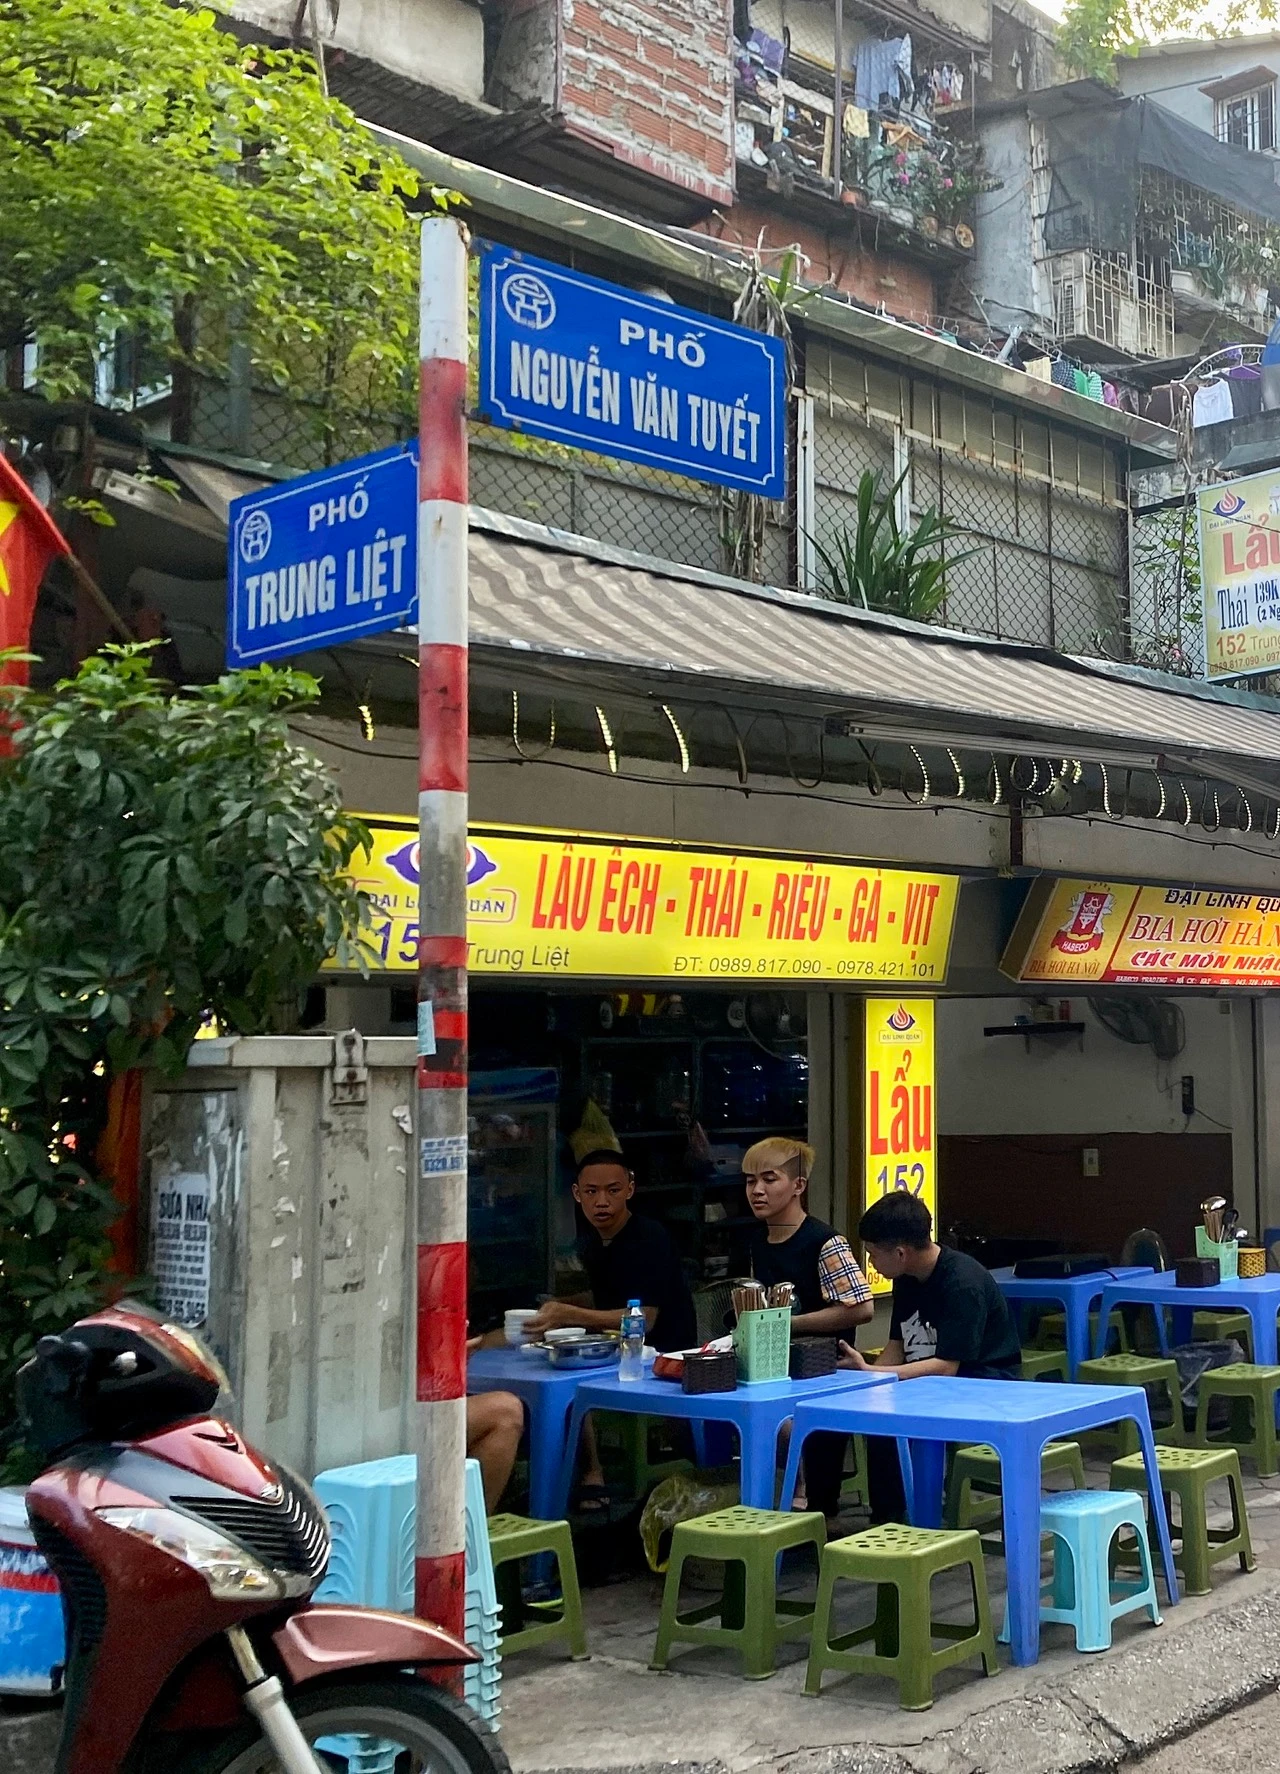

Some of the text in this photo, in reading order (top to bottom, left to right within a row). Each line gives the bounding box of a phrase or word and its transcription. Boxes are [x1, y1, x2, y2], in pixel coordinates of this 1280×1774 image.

[619, 318, 706, 368] PHỐ
[510, 340, 760, 463] NGUYỄN VĂN TUYẾT
[308, 474, 369, 532] PHỐ
[245, 527, 407, 630] TRUNG LIỆT
[1217, 585, 1249, 630] Thái
[1257, 605, 1267, 623] (2
[1216, 633, 1246, 657] 152
[684, 855, 748, 938] THÁI
[767, 862, 830, 941] RIÊU
[848, 869, 882, 943] GÀ
[902, 882, 940, 960] VỊT
[1205, 892, 1252, 911] LINH
[378, 921, 935, 977] 15 Trung Liệt ĐT: 0989.817.090 0978.421.101
[1061, 941, 1089, 952] HABECO
[1129, 915, 1174, 942] BIA
[1178, 917, 1231, 944] HƠI
[1229, 916, 1263, 946] HÀ
[1130, 949, 1175, 967] CÁC
[1178, 952, 1230, 969] MÓN
[870, 1049, 931, 1155] Lẩu
[877, 1163, 925, 1200] 152
